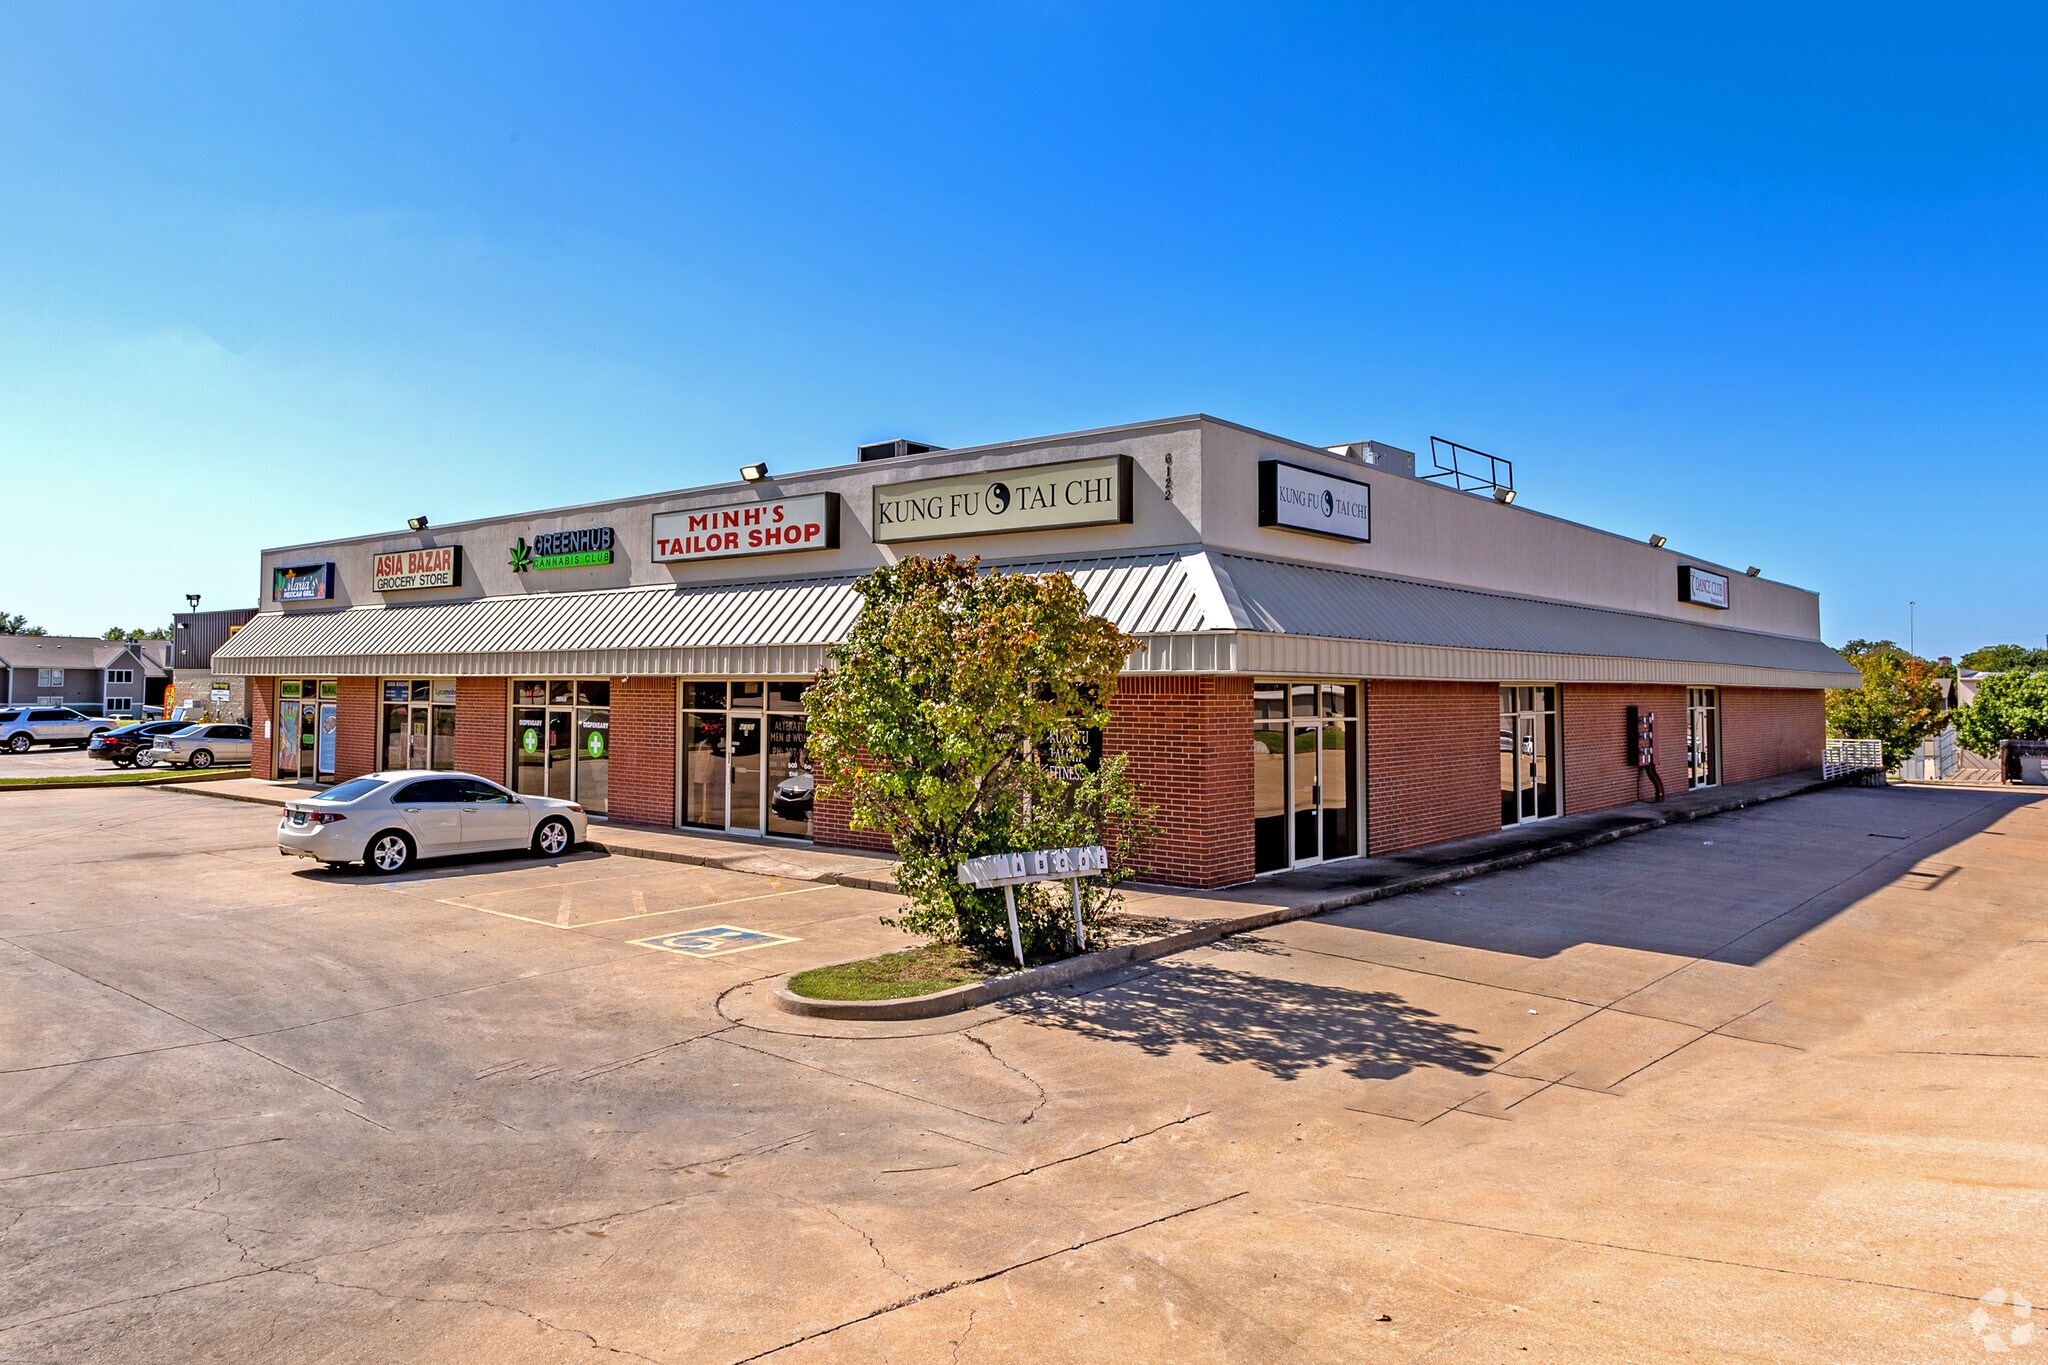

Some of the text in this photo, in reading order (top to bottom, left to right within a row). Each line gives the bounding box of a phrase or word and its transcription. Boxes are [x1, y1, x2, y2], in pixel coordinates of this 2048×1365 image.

[878, 477, 1113, 524] KUNG FU TAI CHI
[1280, 486, 1367, 519] KUNG FU TAI CHI
[688, 505, 784, 532] MINH'S
[533, 527, 613, 556] GREENHUB
[657, 523, 821, 556] TAILOR SHOP
[376, 550, 451, 577] ASIA BAZAR
[534, 553, 609, 568] CANNABIS CLUB
[377, 573, 448, 589] GROCERY STORE
[1696, 577, 1711, 594] DANCE
[1712, 582, 1722, 597] CLUB
[770, 732, 783, 741] MEN
[785, 734, 791, 742] &
[1016, 863, 1022, 872] A
[1039, 860, 1044, 869] B
[1061, 858, 1065, 868] C
[1081, 856, 1086, 866] D
[1100, 855, 1104, 864] E
